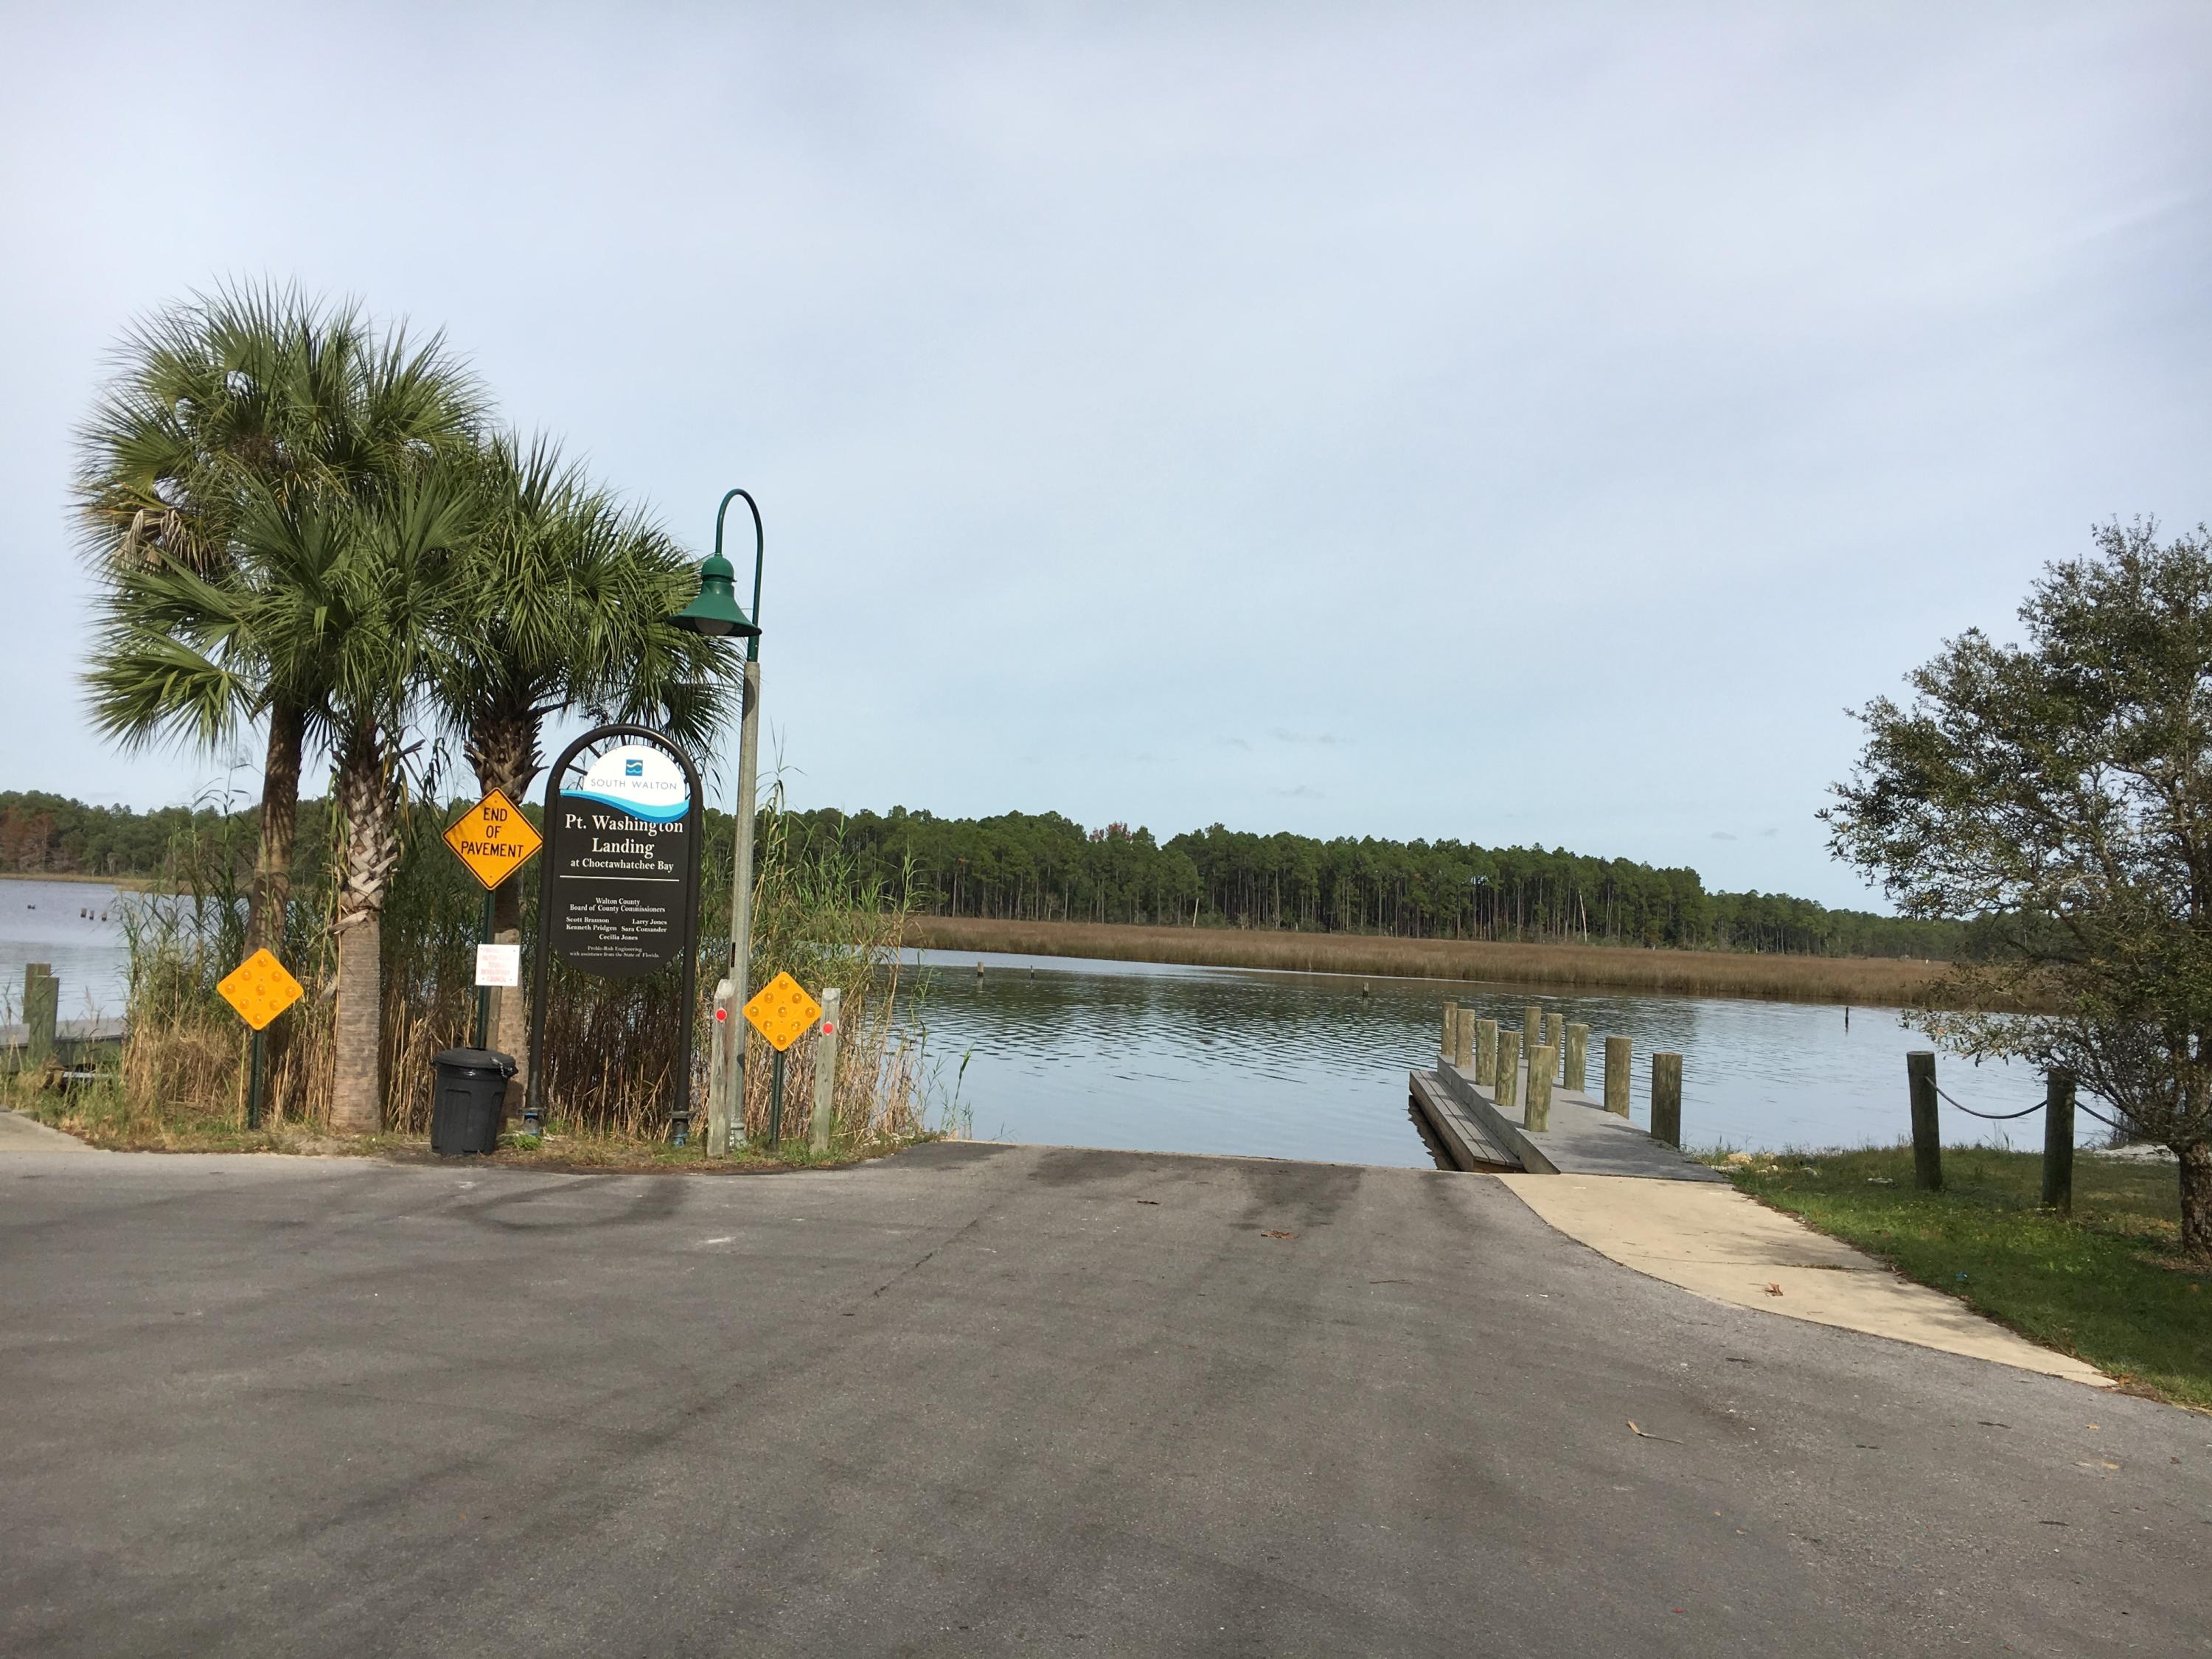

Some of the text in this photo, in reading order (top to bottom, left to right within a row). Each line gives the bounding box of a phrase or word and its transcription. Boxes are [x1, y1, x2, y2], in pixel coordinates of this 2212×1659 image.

[591, 779, 677, 790] SOUTH WALTON
[483, 807, 508, 821] END
[486, 825, 502, 838] OF
[565, 814, 684, 837] Pt. Washington
[461, 841, 524, 858] PAVEMENT
[591, 838, 655, 858] Landing
[570, 858, 674, 873] at Choctawhatchee Bay
[619, 898, 640, 907] County
[598, 905, 619, 914] County
[620, 905, 666, 913] Commissioners
[632, 918, 649, 926] Larry
